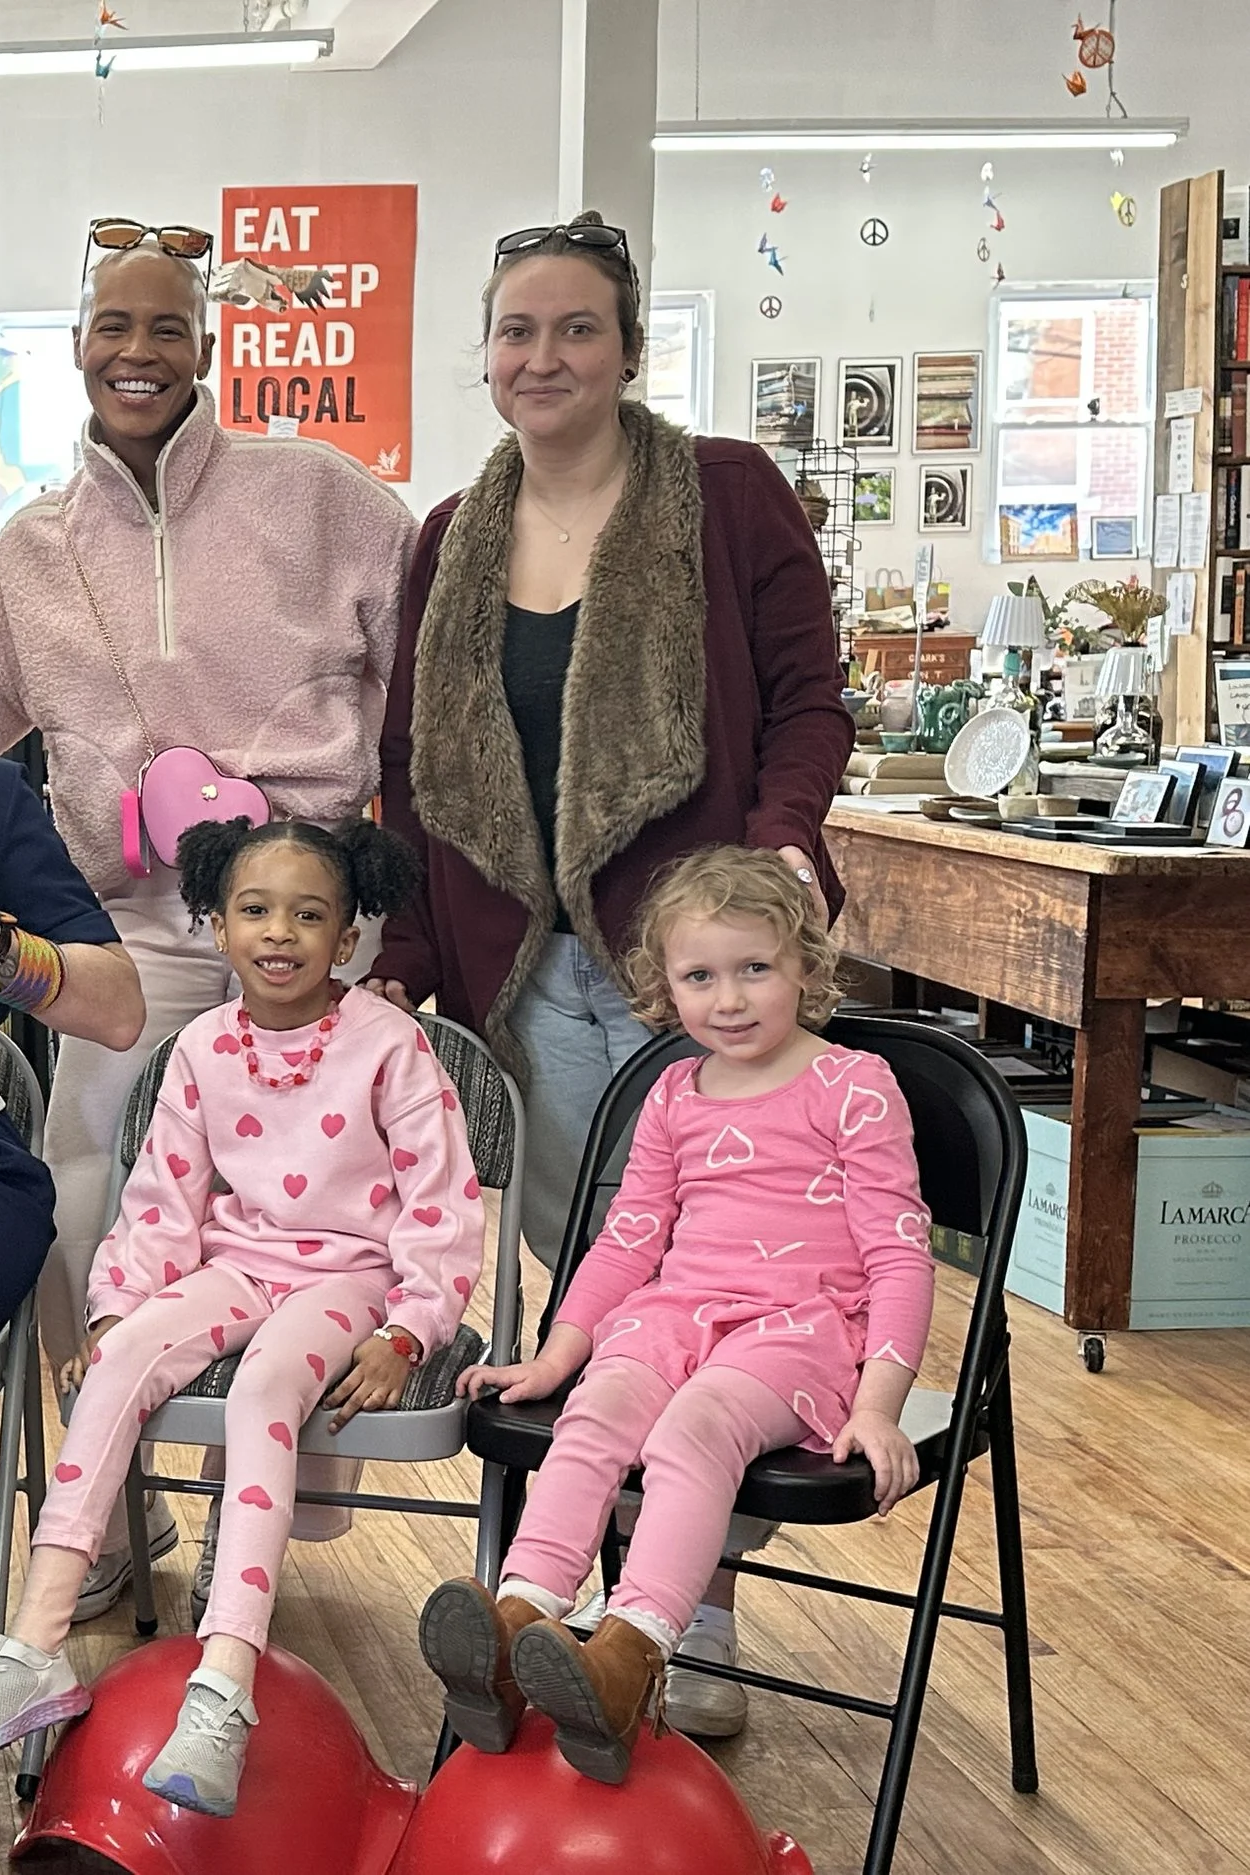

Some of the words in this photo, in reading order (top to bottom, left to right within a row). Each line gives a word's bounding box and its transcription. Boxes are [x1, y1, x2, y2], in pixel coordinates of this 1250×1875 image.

[234, 206, 320, 253] EAT
[232, 322, 355, 368] READ
[232, 376, 366, 424] LOCAL
[908, 653, 945, 663] CARK'S
[1028, 1187, 1066, 1221] LAMARC
[1174, 1233, 1242, 1245] PROSECCO
